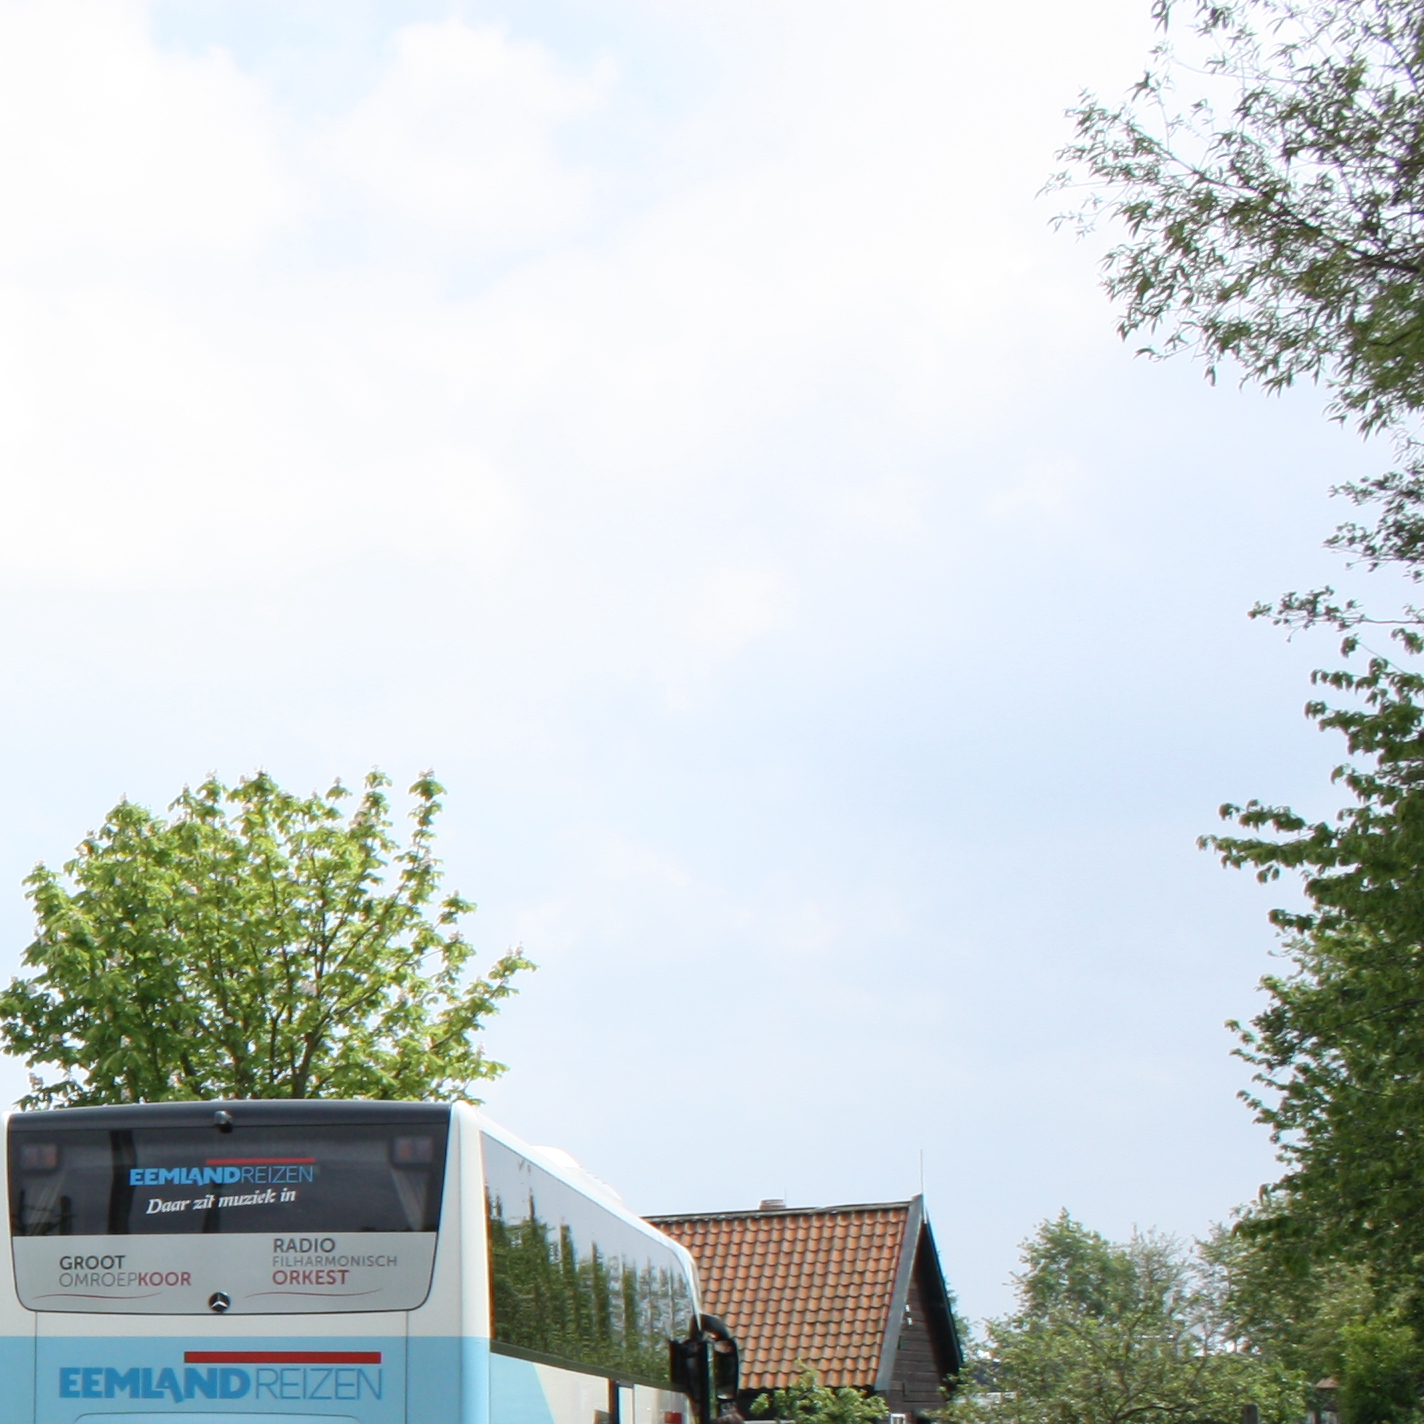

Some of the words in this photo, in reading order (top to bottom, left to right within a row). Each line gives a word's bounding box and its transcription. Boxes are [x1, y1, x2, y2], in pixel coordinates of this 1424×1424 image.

[146, 1199, 189, 1214] Daar
[192, 1194, 215, 1209] zit
[218, 1188, 275, 1207] muziek
[280, 1187, 296, 1202] in
[273, 1237, 336, 1253] RADIO
[59, 1255, 126, 1270] GROOT
[272, 1255, 398, 1267] FILHARMONISCH
[272, 1269, 350, 1285] ORKEST
